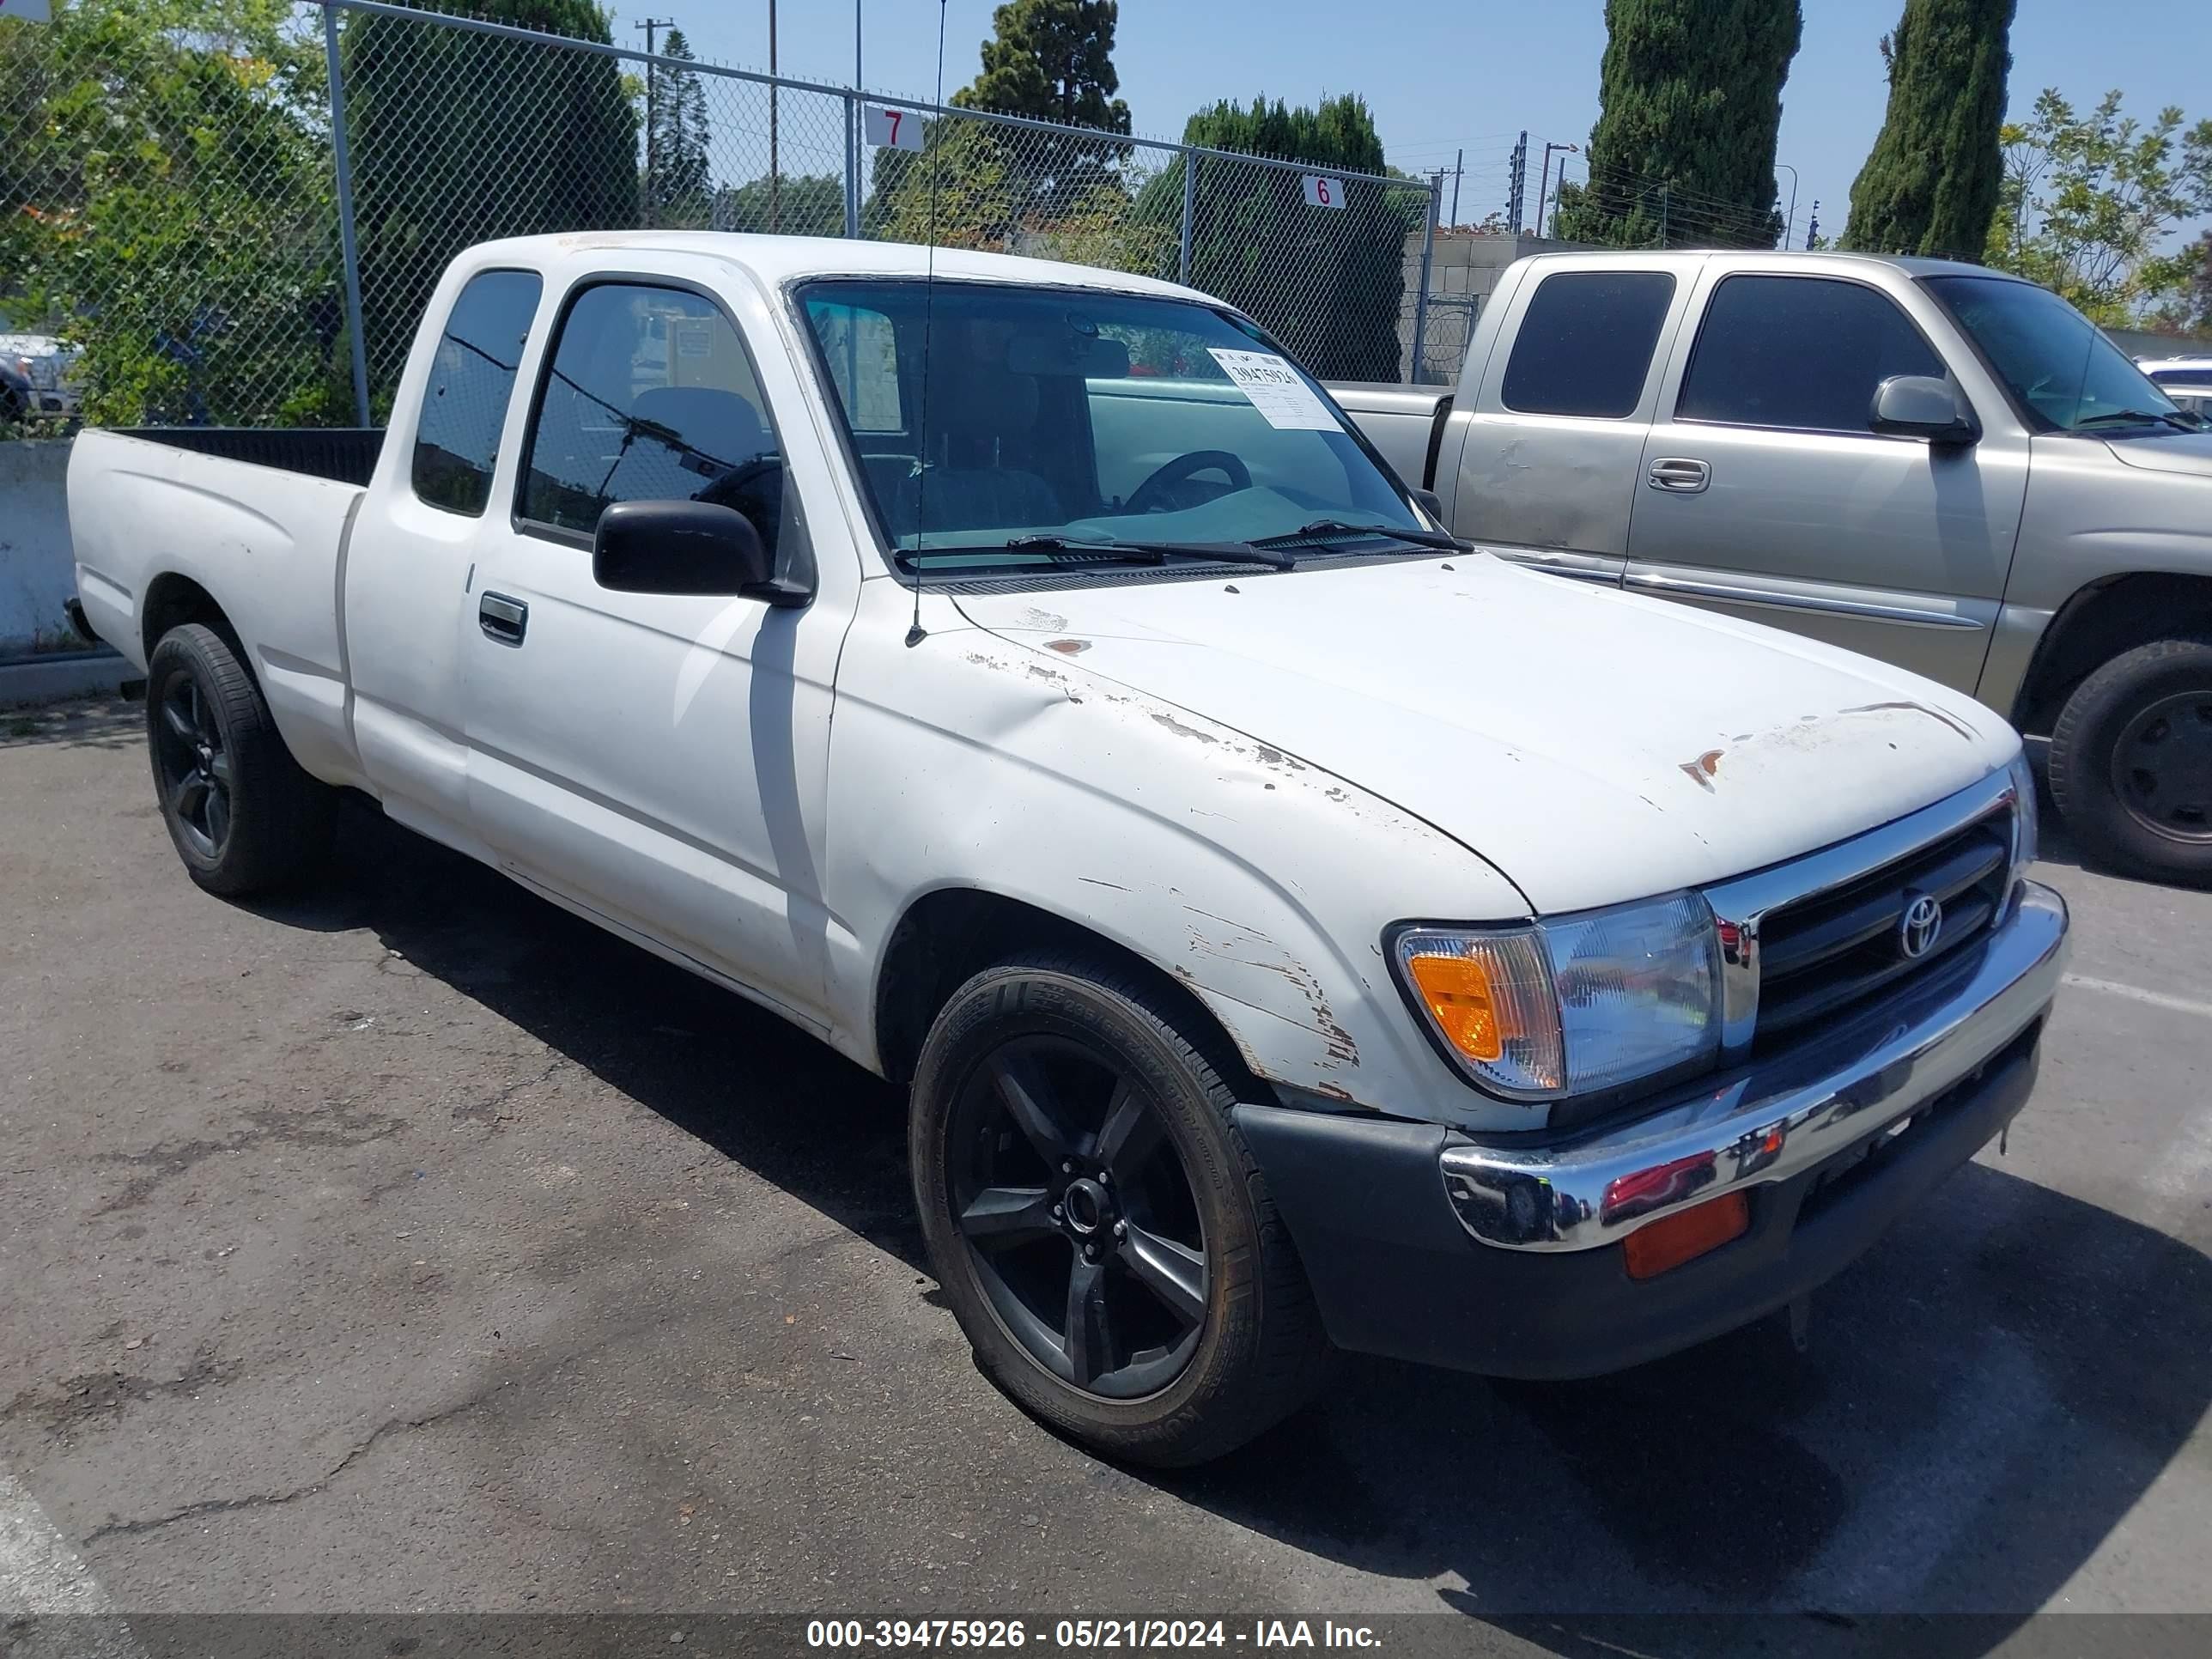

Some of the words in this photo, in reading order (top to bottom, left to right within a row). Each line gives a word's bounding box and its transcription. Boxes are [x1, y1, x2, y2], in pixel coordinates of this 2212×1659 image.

[885, 111, 902, 146] 7
[1317, 179, 1331, 205] 6
[1231, 366, 1298, 386] 39475926
